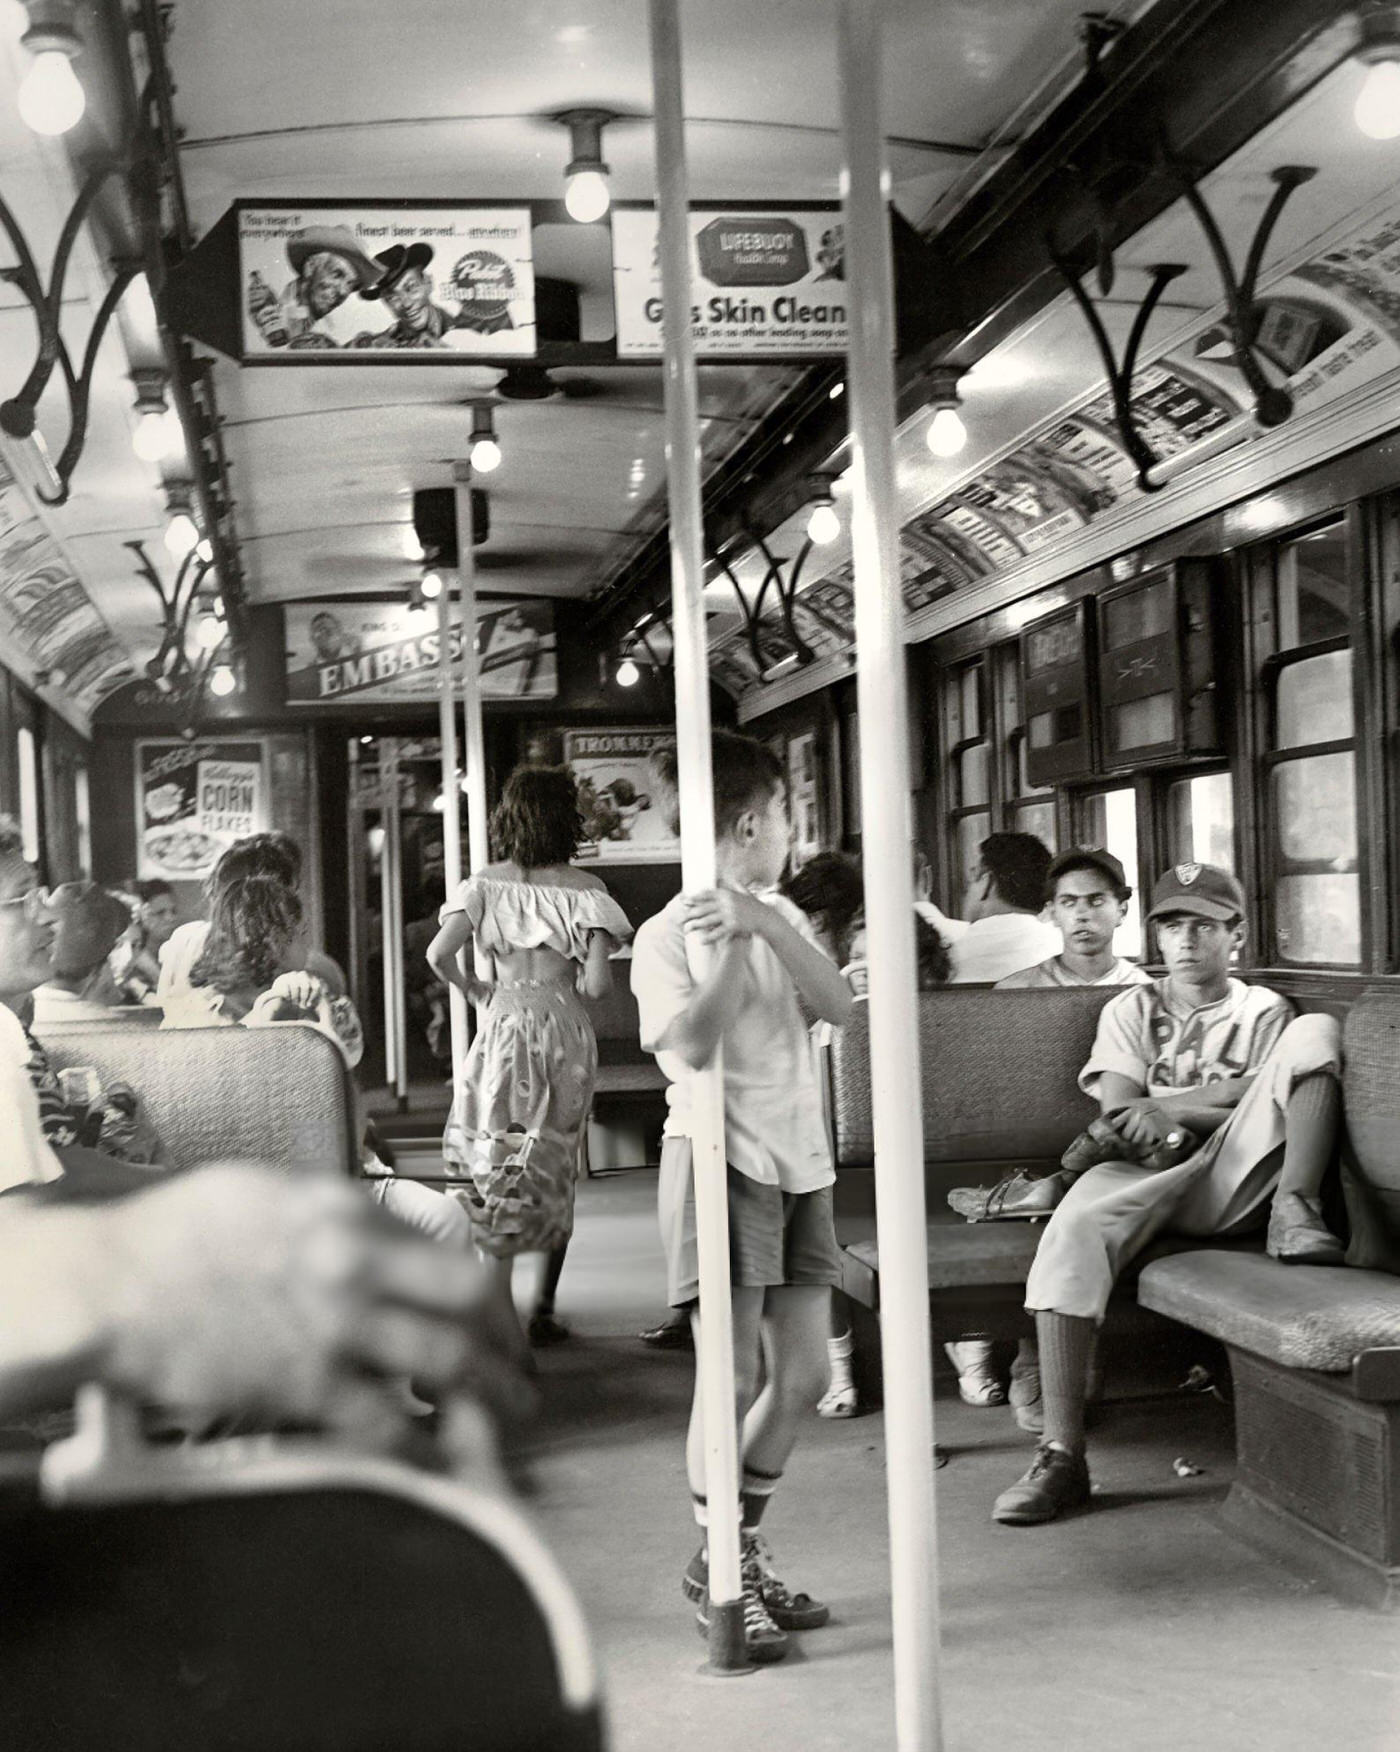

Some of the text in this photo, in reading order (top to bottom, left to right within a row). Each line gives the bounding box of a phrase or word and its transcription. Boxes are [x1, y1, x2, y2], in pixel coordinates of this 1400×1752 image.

[392, 222, 417, 237] beer
[719, 231, 794, 251] LIFEBUOY
[458, 258, 507, 280] Pabst
[645, 296, 847, 323] Gs Skin Clean
[319, 628, 480, 698] EMBASS
[202, 783, 254, 813] CORN
[1150, 1015, 1247, 1070] PAL
